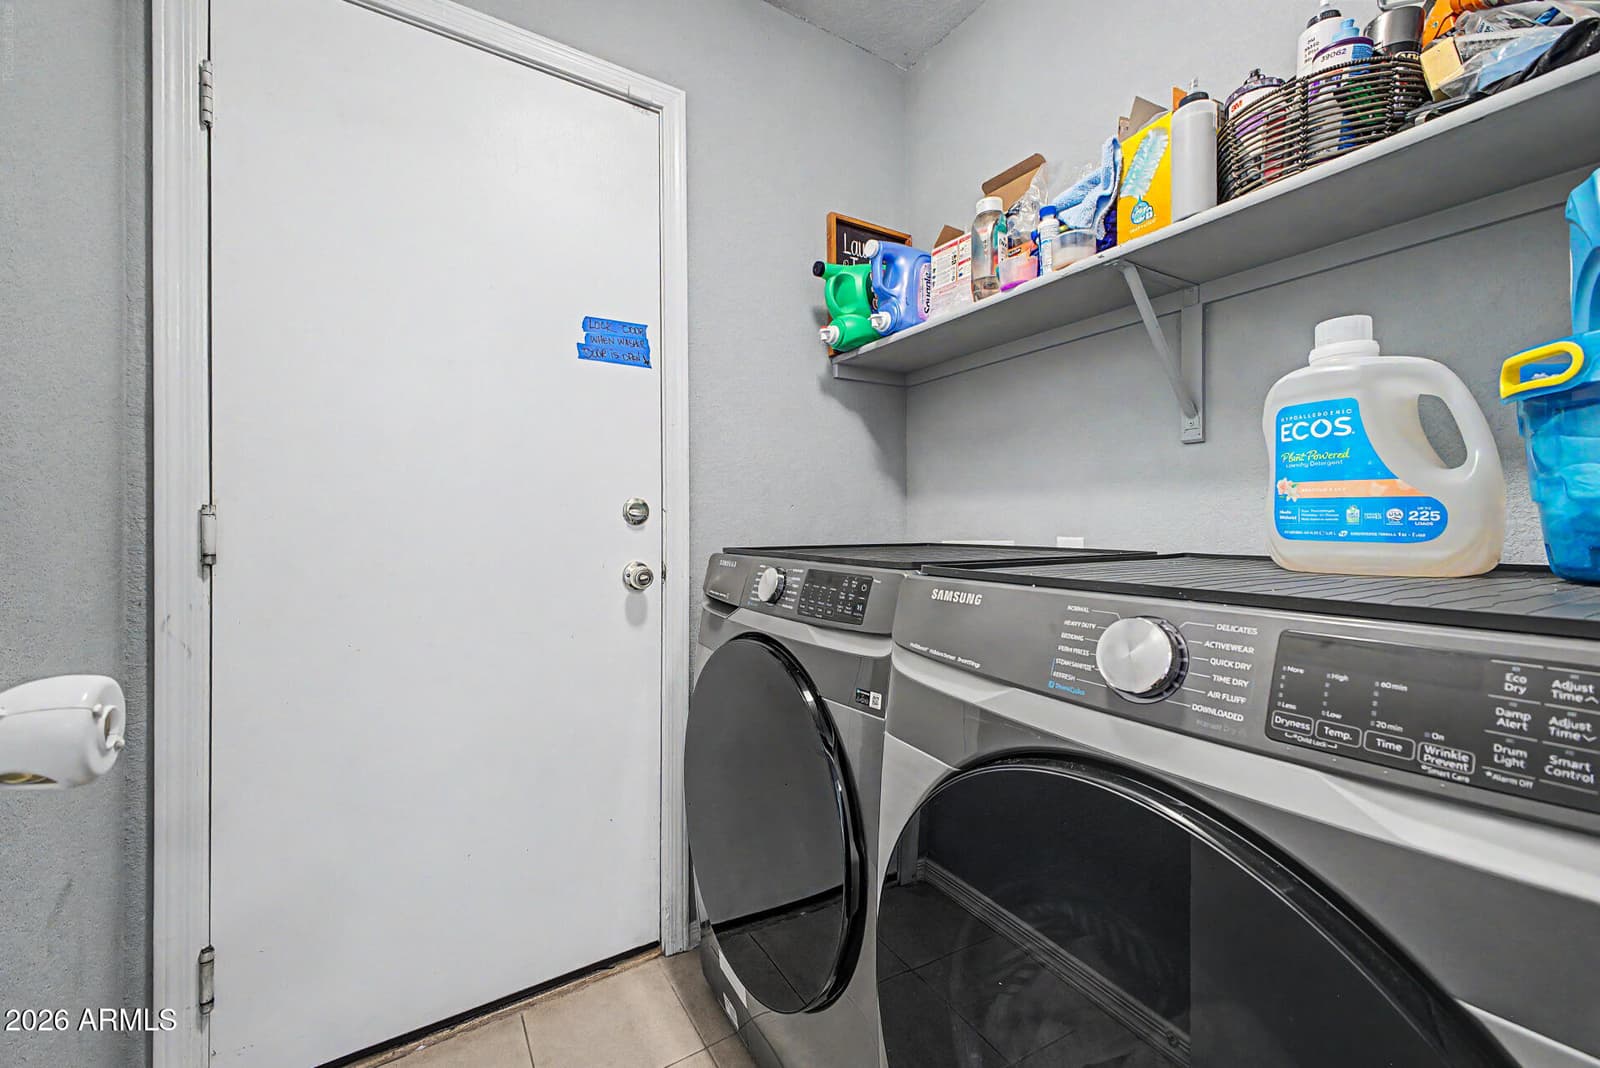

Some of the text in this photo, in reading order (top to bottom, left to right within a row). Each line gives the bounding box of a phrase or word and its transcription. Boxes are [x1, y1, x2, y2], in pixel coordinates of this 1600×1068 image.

[1281, 447, 1351, 463] Plant Powered
[1408, 510, 1441, 522] 225
[931, 588, 983, 605] SAMSUNG
[1216, 624, 1259, 636] DELICATES
[1203, 640, 1256, 655] ACTIVEWEAR
[1210, 657, 1252, 671] QUICK DRY
[1287, 666, 1305, 674] More
[1212, 674, 1250, 688] TIME DRY
[1330, 673, 1349, 683] High
[1504, 672, 1528, 685] Eco
[1380, 681, 1408, 692] 60 min
[1504, 682, 1527, 696] Dry
[1552, 679, 1595, 695] Adjust
[1207, 690, 1247, 705] AIR FLUFF
[1551, 689, 1584, 703] Time
[1192, 703, 1244, 722] DOWNLOADED
[1281, 701, 1297, 710] Less
[1326, 711, 1342, 720] Low
[1495, 707, 1532, 722] Damp
[1274, 715, 1311, 731] Dryness
[1375, 720, 1403, 733] 20 min
[1496, 717, 1528, 732] Alert
[1548, 716, 1593, 733] Adjust
[1323, 726, 1353, 741] Temp.
[1431, 732, 1445, 742] On
[1548, 726, 1582, 742] Time
[1376, 738, 1403, 753] Time
[1492, 743, 1529, 759] Drum
[1423, 744, 1470, 763] Wrinkle
[1423, 754, 1470, 772] Prevent
[1493, 754, 1527, 770] Light
[1549, 755, 1591, 773] Smart
[1451, 772, 1470, 784] Care
[1543, 764, 1595, 785] Control
[1518, 777, 1534, 790] Off
